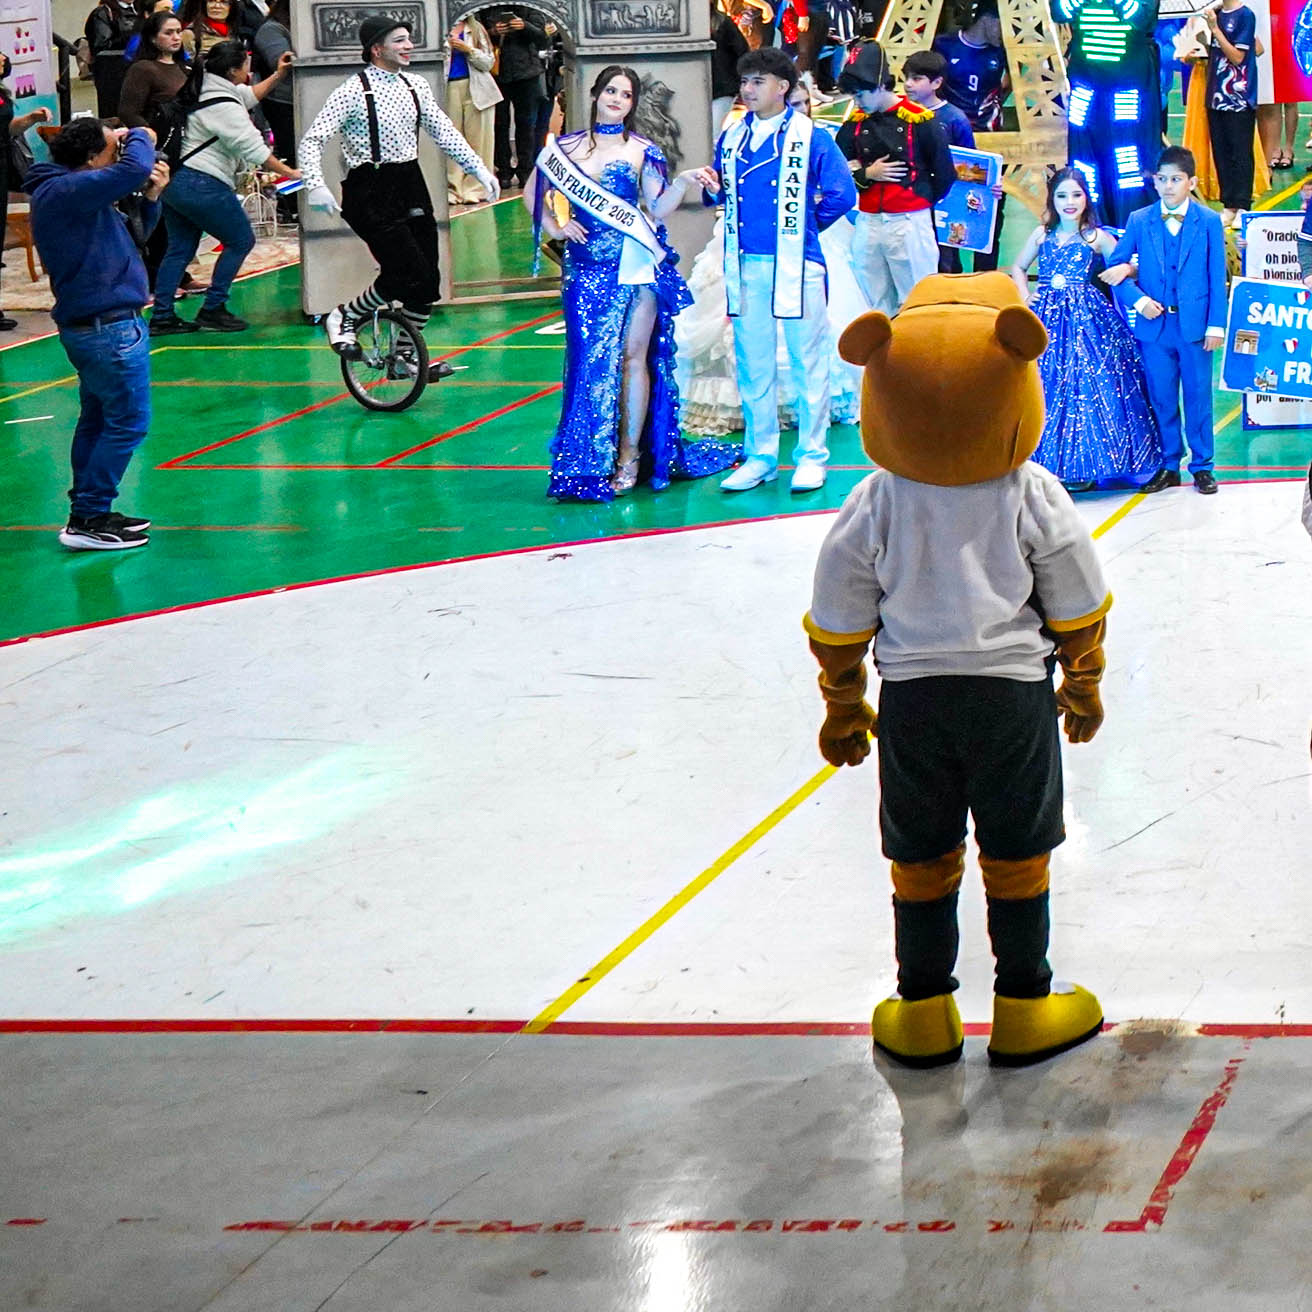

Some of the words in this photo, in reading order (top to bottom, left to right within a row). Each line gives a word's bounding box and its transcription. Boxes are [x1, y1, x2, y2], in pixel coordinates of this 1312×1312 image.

[968, 74, 978, 92] 9
[545, 152, 568, 181] MISS
[563, 175, 609, 214] FRANCE
[608, 206, 636, 228] 2025
[784, 141, 804, 228] FRANCE
[1265, 253, 1279, 265] Oh
[1281, 251, 1298, 265] Dio
